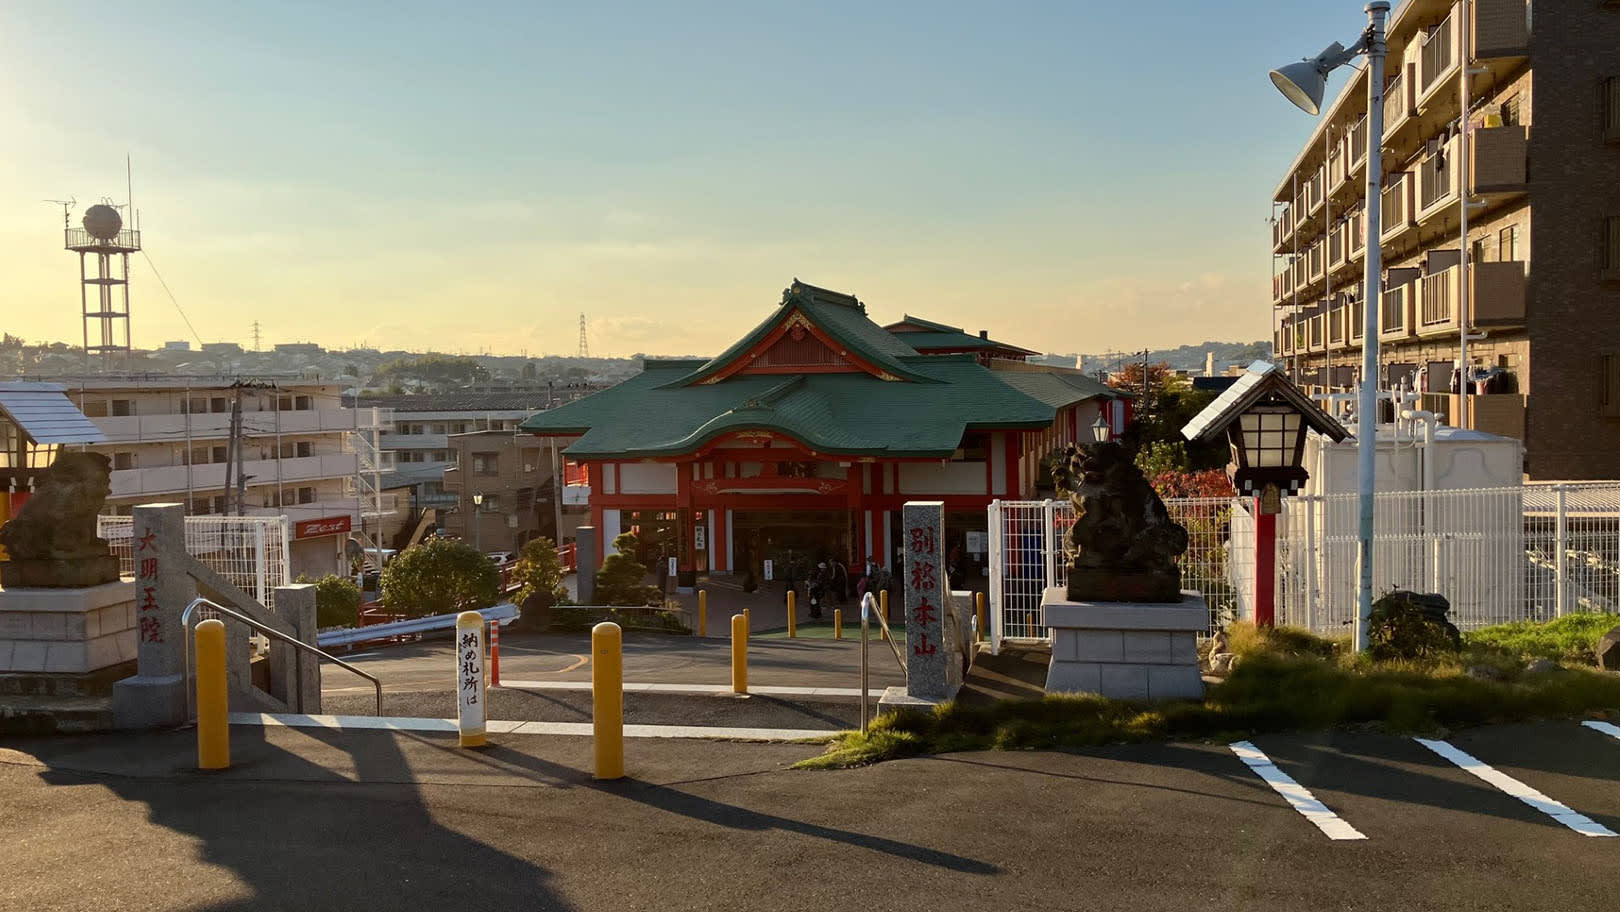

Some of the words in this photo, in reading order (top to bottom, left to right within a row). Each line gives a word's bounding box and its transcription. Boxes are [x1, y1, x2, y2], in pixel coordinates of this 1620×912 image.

[139, 527, 165, 643] 大明王院
[909, 526, 937, 657] 別格本山
[462, 632, 480, 706] 納め札所は
